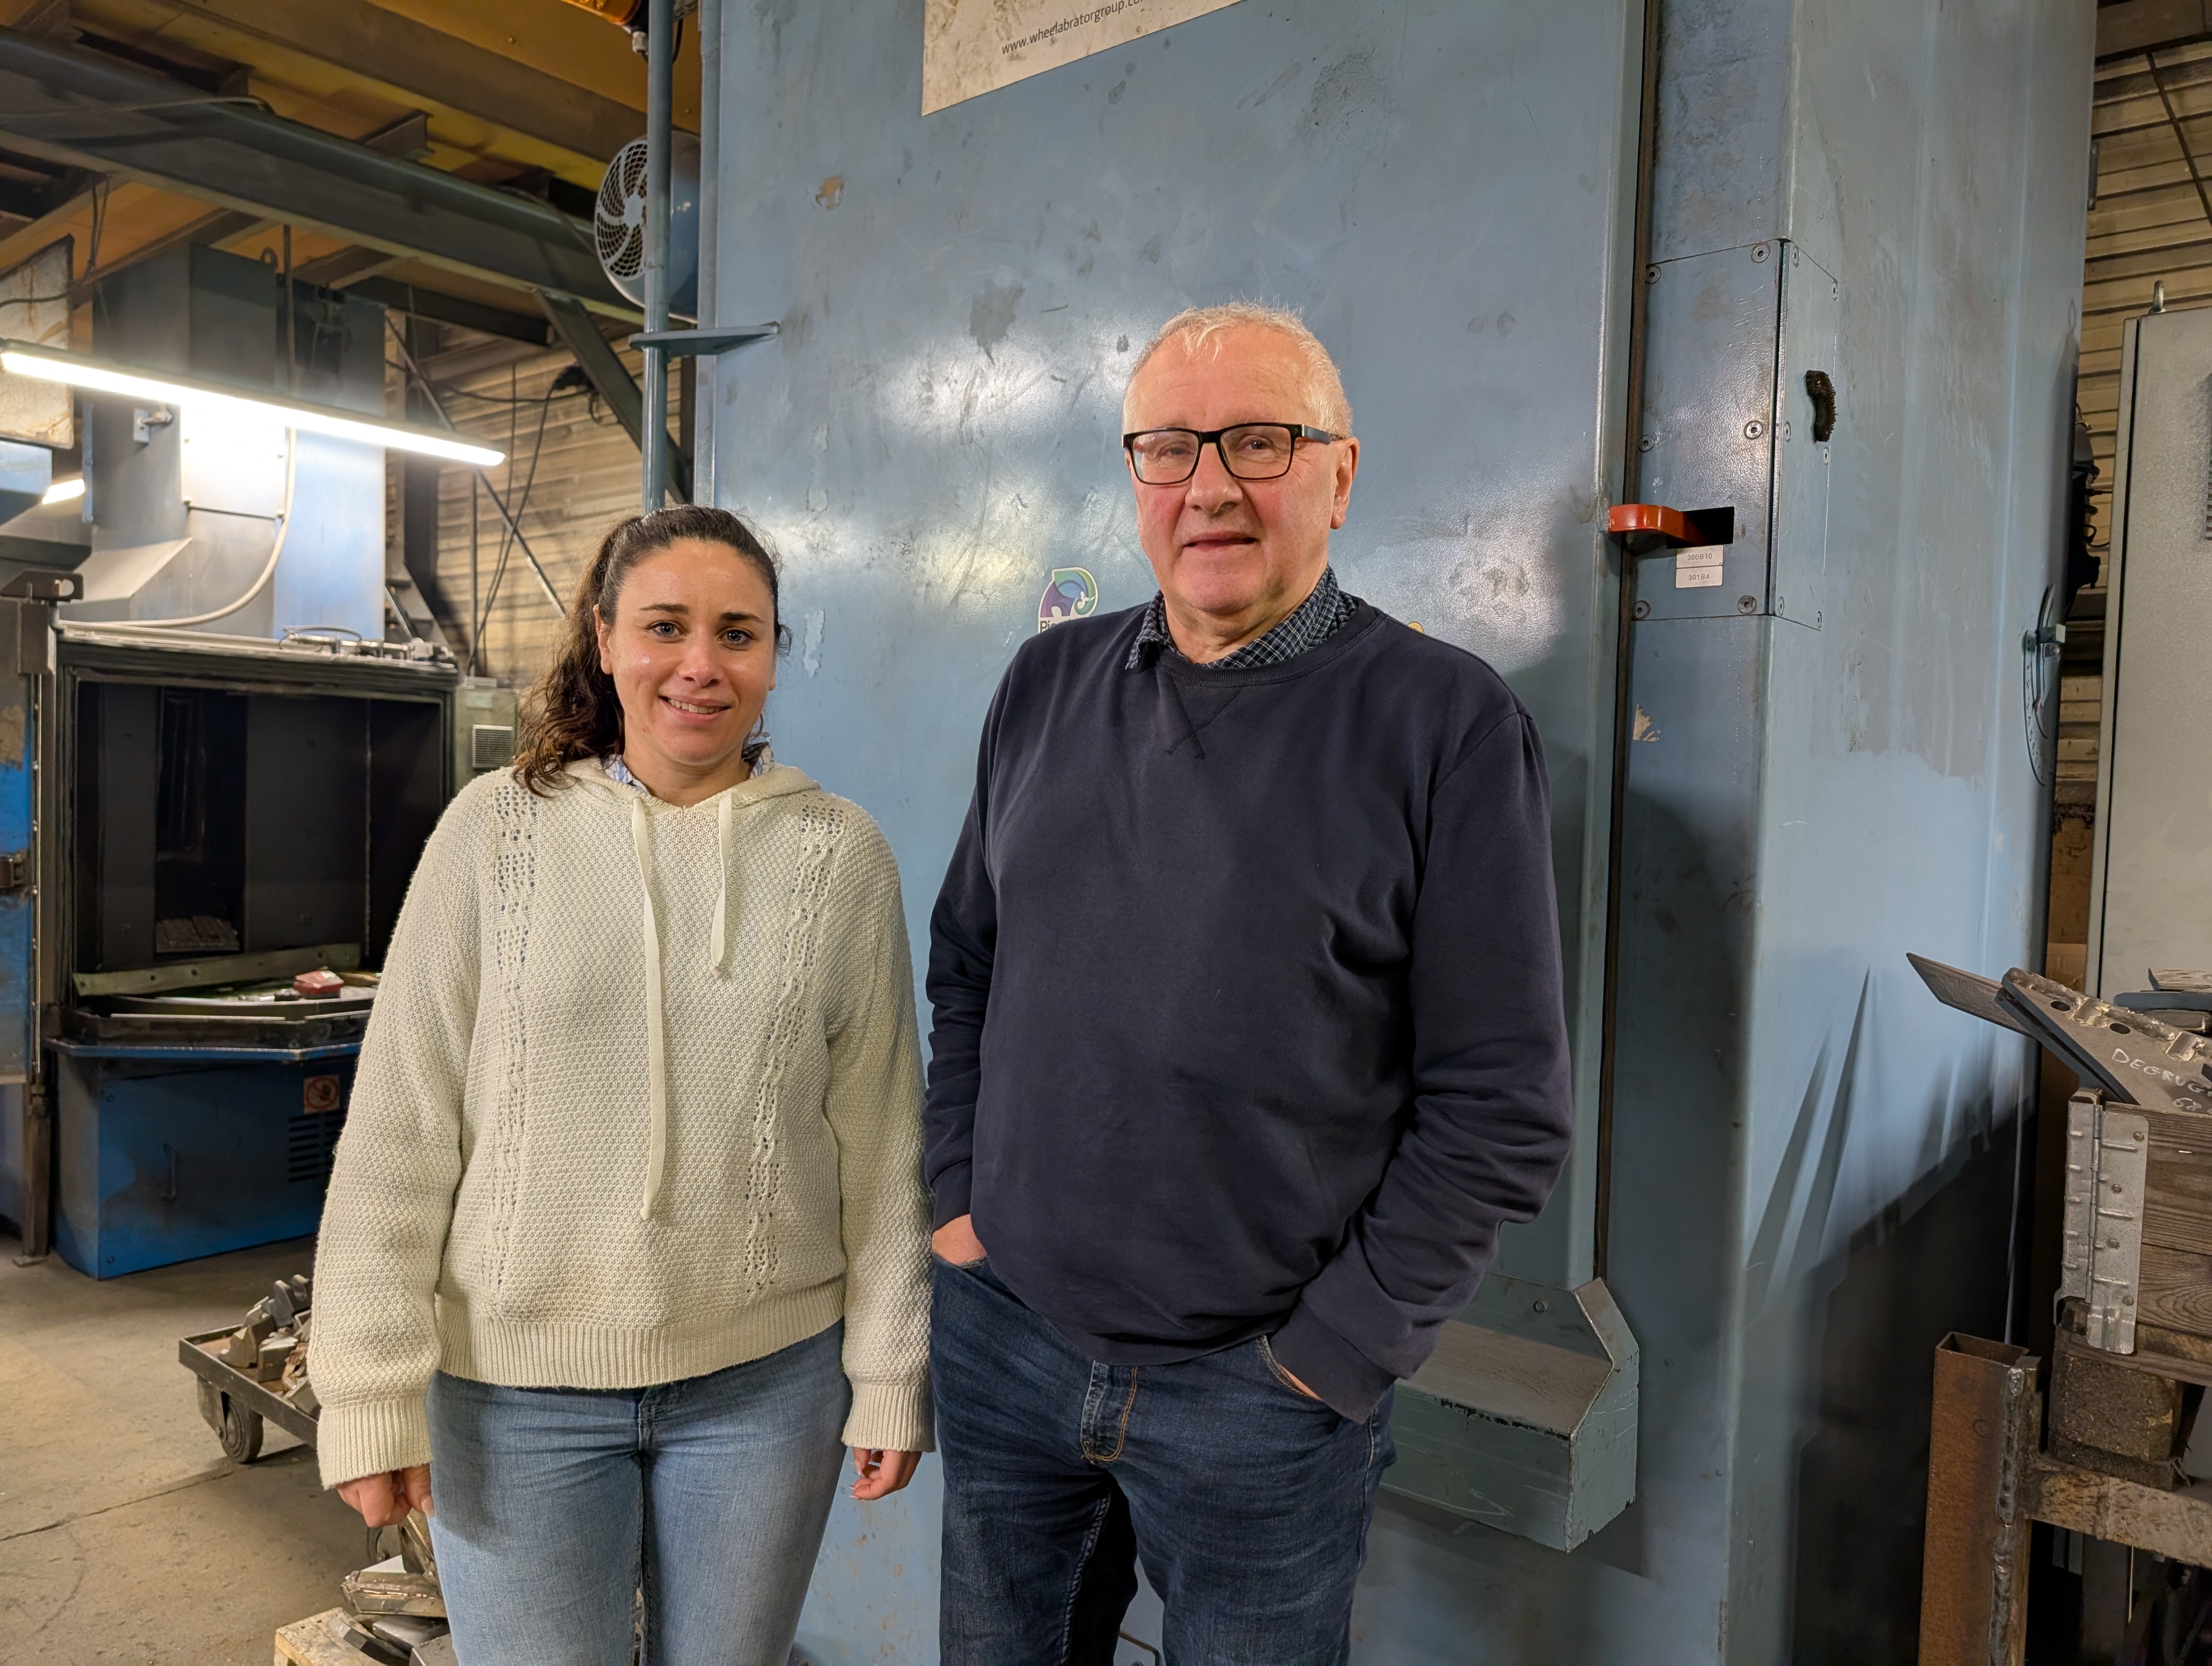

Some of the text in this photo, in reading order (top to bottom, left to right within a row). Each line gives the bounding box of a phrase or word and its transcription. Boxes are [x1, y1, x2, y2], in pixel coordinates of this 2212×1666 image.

[1002, 0, 1142, 54] www.wheelabratorgroup.c
[1687, 553, 1712, 561] 300B10
[2112, 1048, 2212, 1097] DEGRUG
